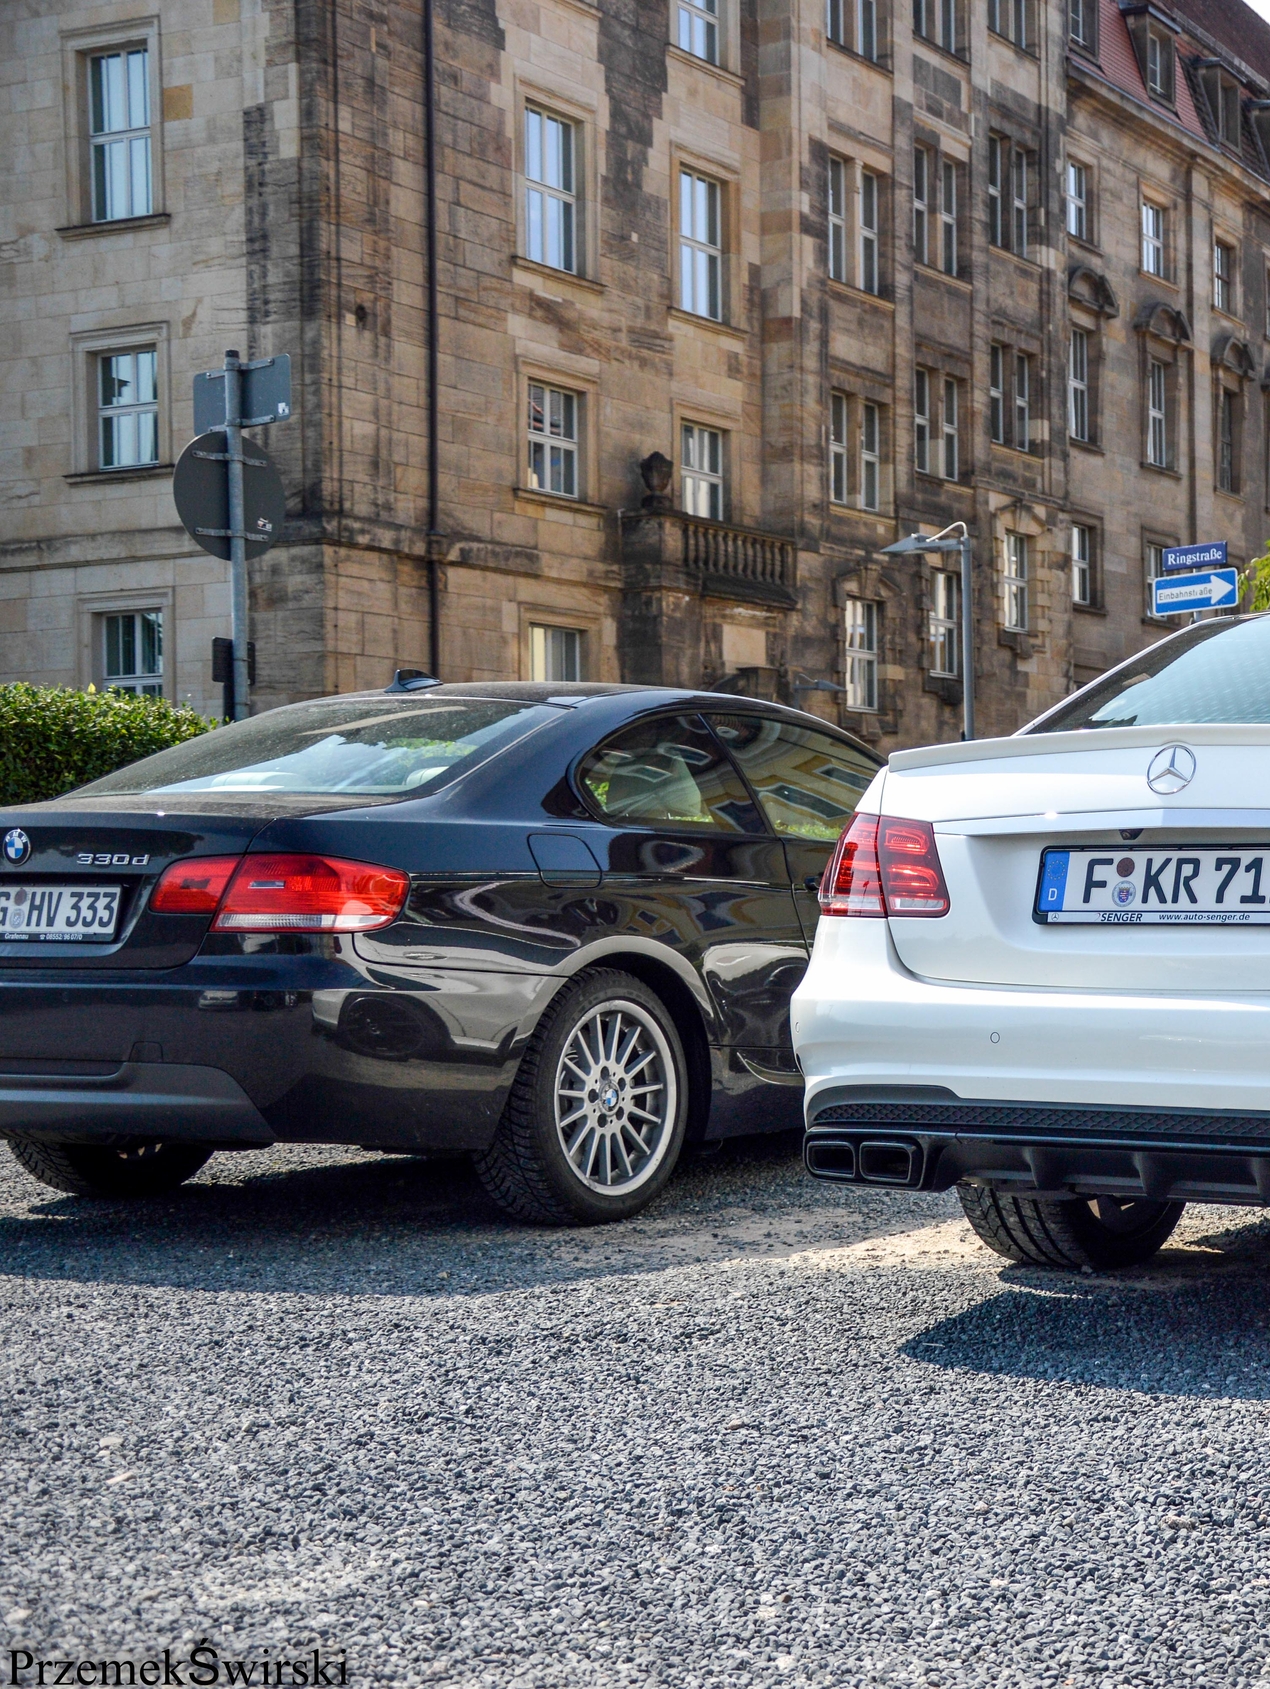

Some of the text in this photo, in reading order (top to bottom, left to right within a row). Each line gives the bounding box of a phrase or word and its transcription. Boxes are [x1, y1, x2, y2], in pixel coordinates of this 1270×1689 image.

[1167, 548, 1222, 565] Ringstraße
[77, 853, 149, 866] 330d
[1141, 857, 1201, 904] KR
[1047, 888, 1058, 901] D
[25, 891, 63, 927] HV
[65, 891, 117, 928] 333
[1100, 912, 1250, 922] SENGER www.auto-senger.de
